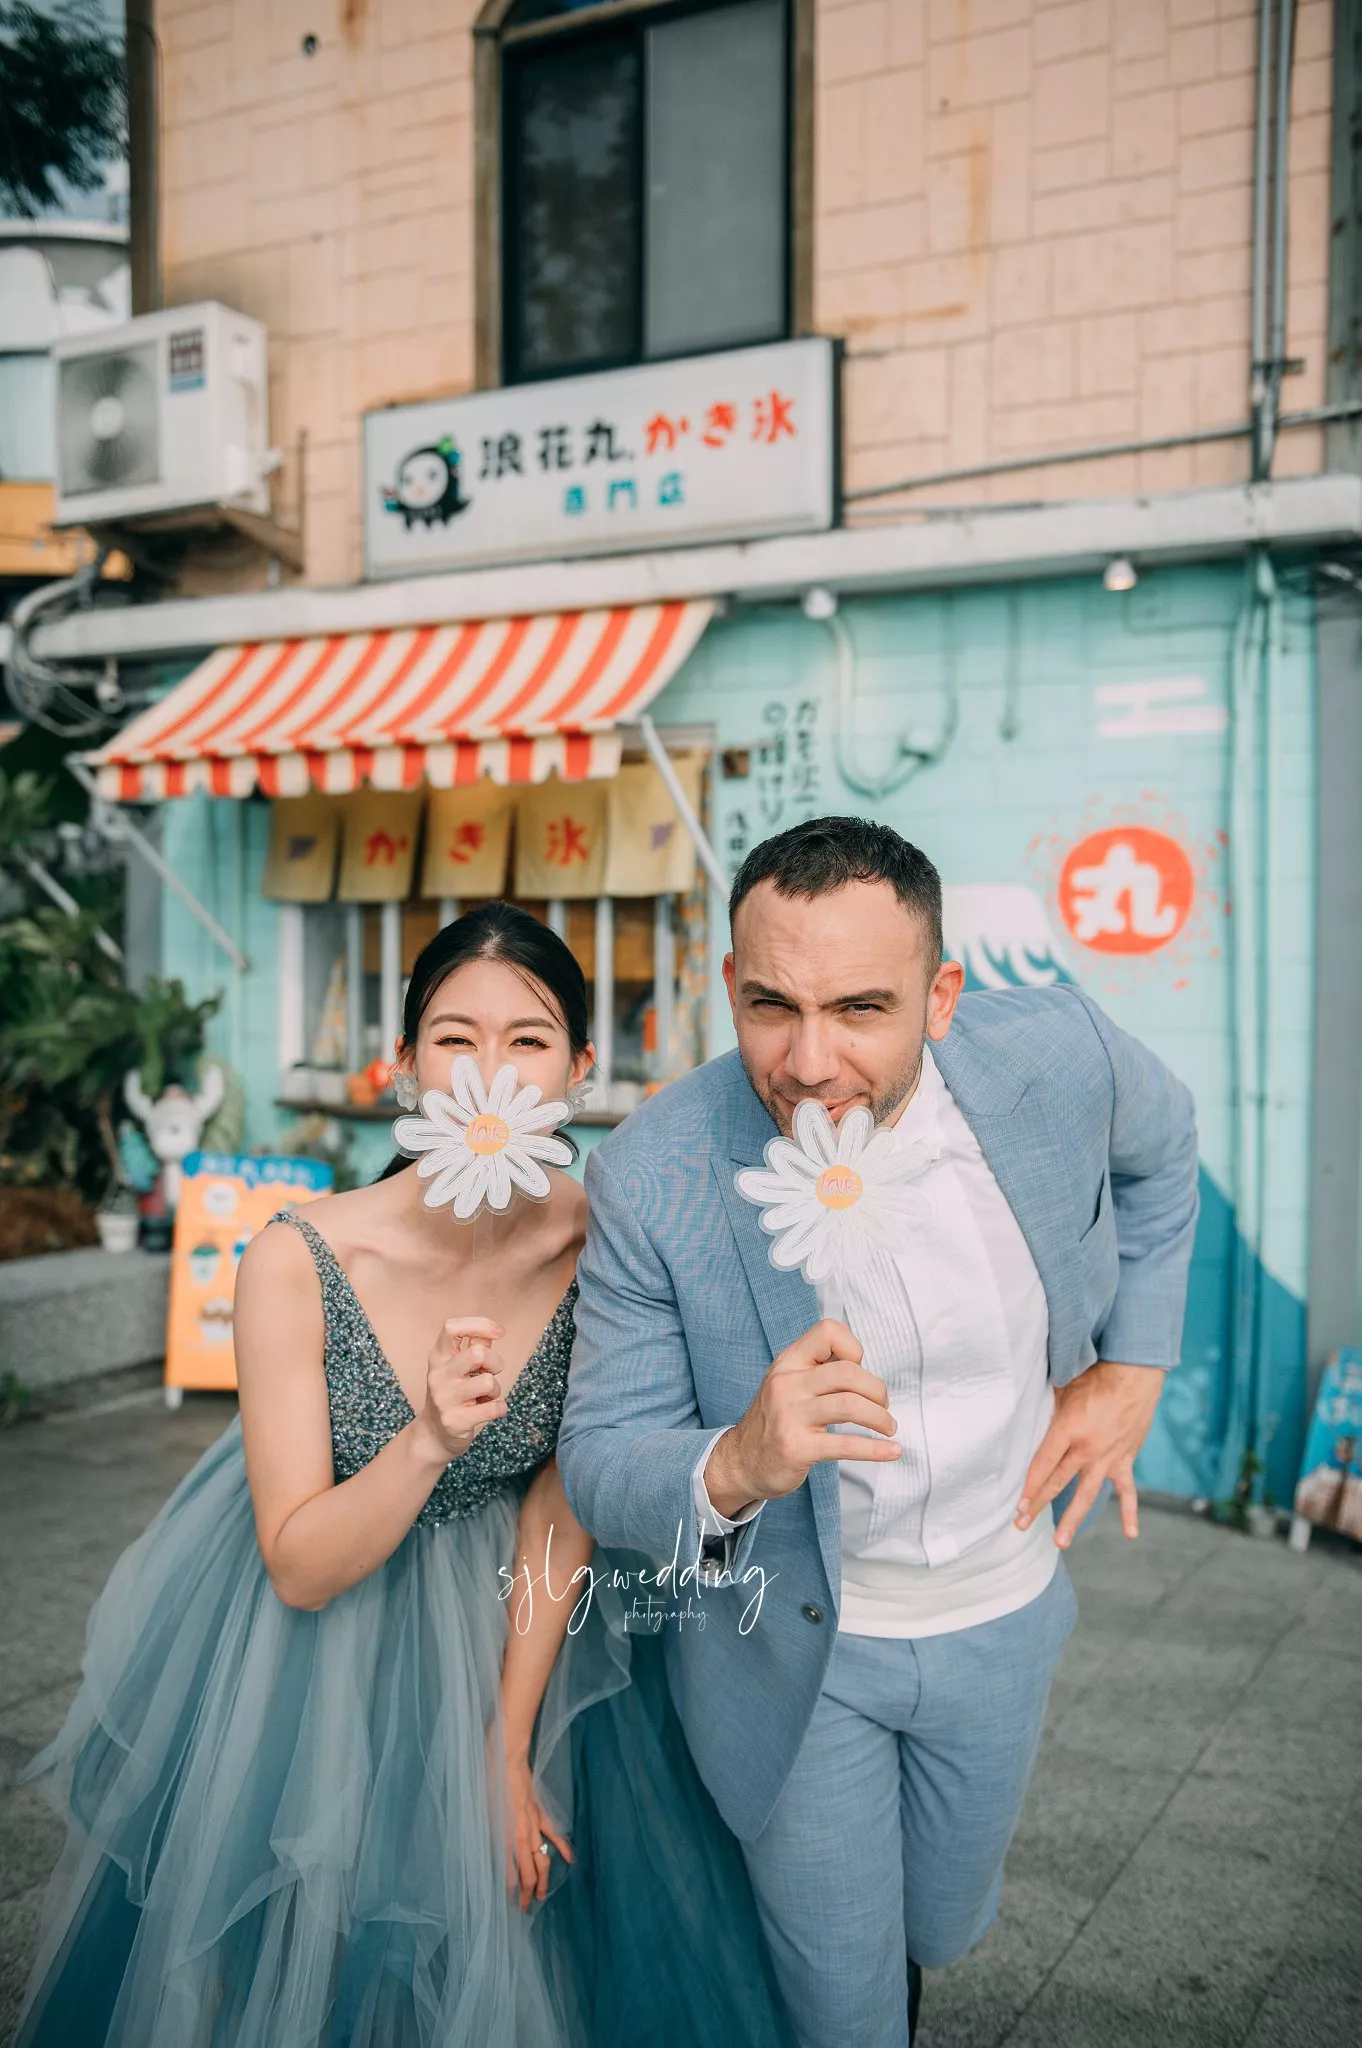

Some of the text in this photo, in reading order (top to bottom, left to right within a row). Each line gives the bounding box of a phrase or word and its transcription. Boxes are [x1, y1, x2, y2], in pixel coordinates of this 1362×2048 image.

[365, 815, 590, 869] かき氷
[1070, 843, 1178, 940] 丸
